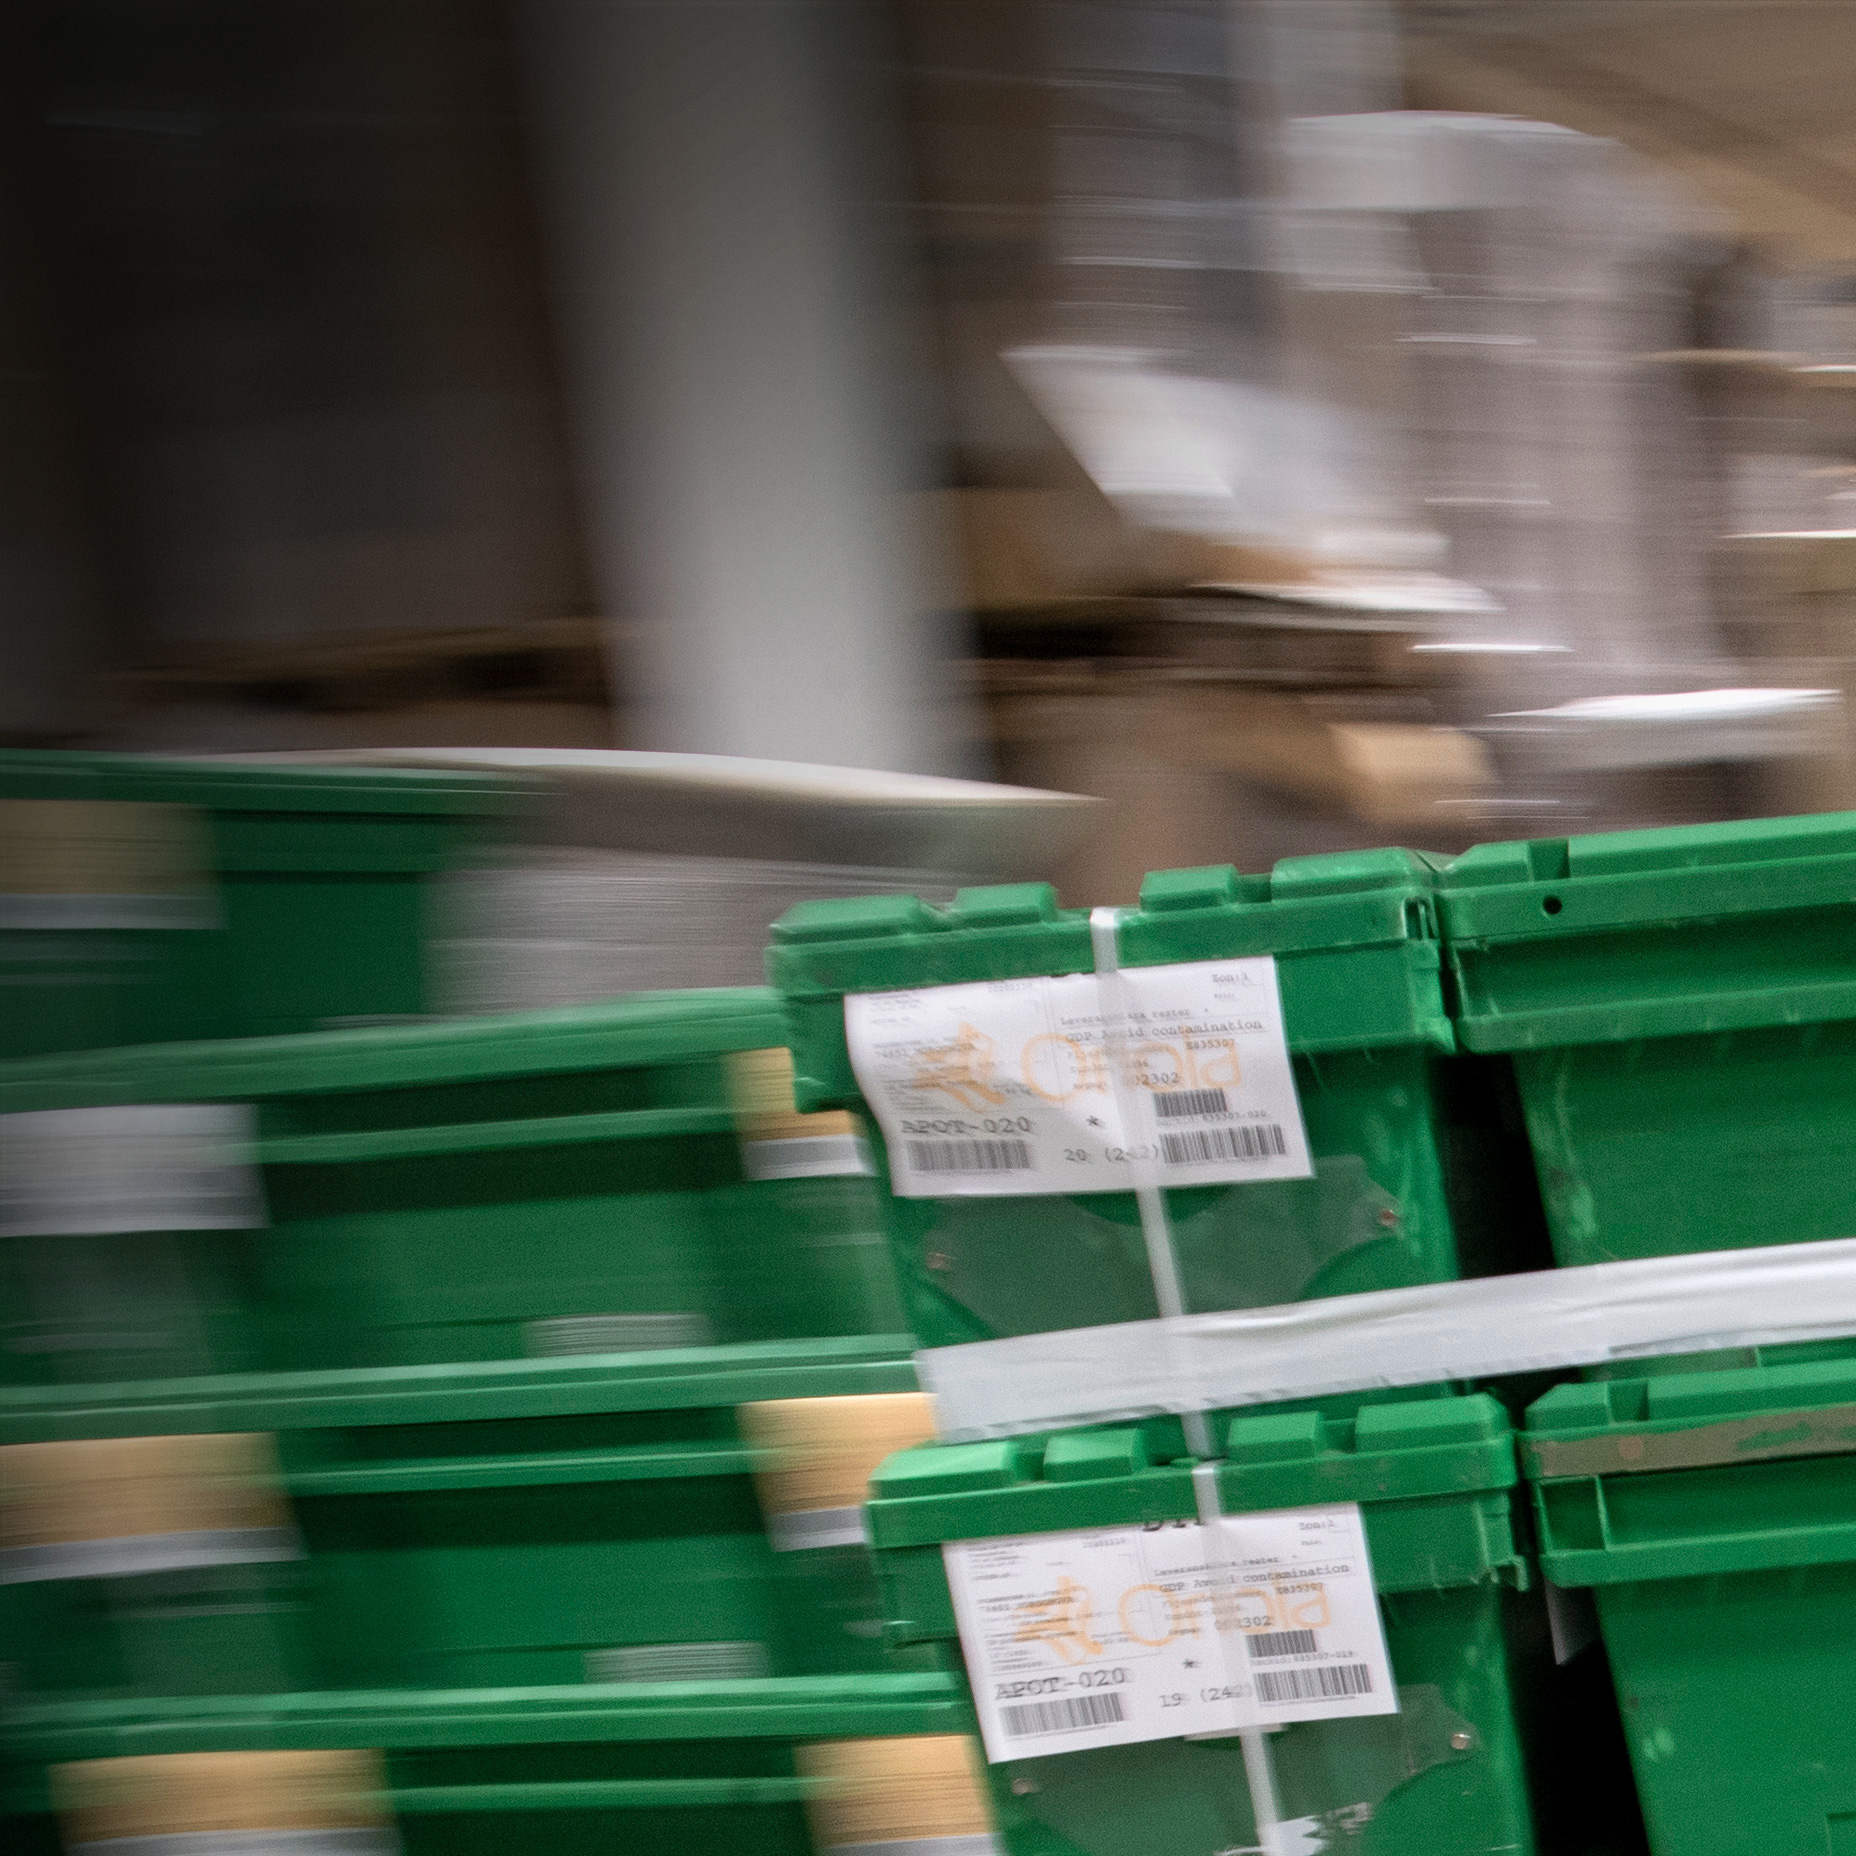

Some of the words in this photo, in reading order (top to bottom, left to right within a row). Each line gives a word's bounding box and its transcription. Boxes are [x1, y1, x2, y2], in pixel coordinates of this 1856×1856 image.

[1151, 1018, 1264, 1037] contamination
[1123, 1072, 1181, 1088] 2302
[901, 1115, 1034, 1135] APOT-020
[1062, 1147, 1089, 1162] 20
[1243, 1562, 1350, 1584] contamination
[1215, 1615, 1272, 1631] 302
[996, 1667, 1130, 1700] APOT-020
